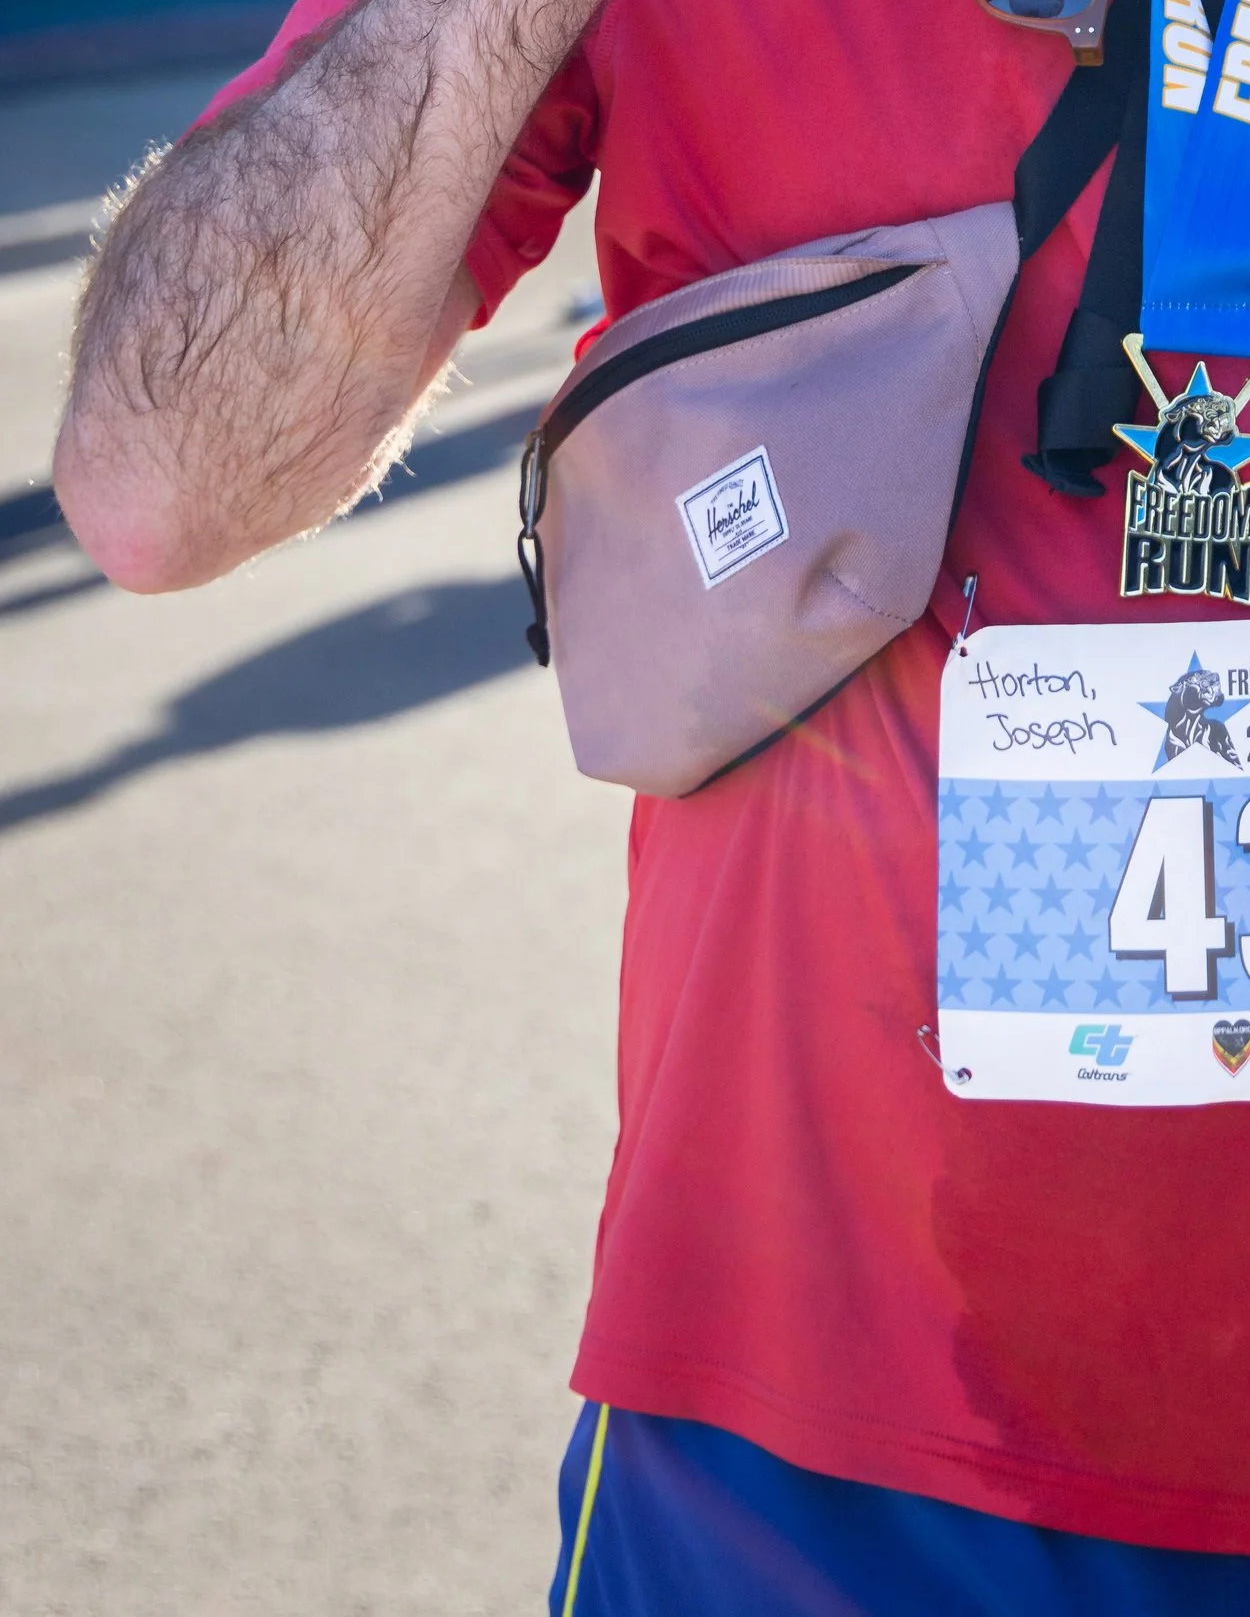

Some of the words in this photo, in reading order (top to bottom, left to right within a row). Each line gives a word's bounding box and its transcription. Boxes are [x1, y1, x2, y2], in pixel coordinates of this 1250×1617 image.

[707, 480, 760, 546] Herschel
[969, 661, 1097, 701] Horton,
[986, 712, 1117, 754] Joseph
[1077, 1068, 1129, 1082] Caltrans
